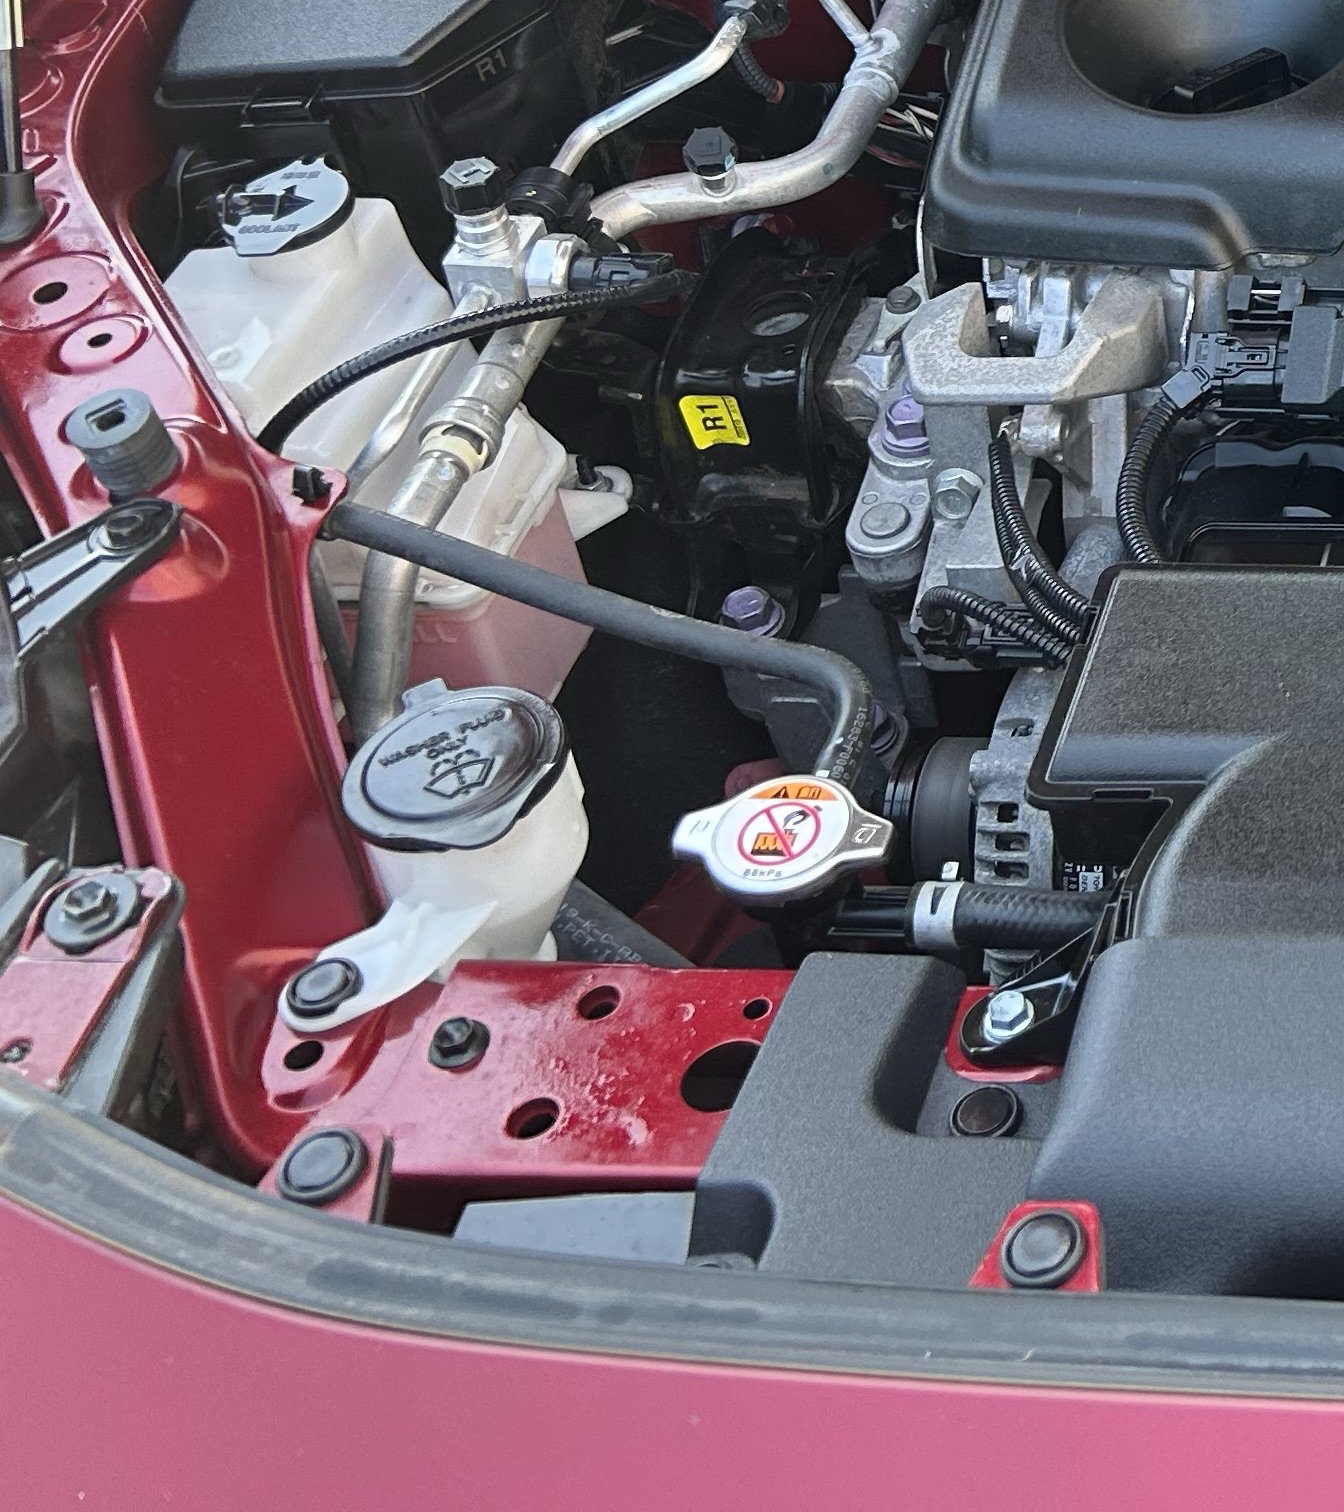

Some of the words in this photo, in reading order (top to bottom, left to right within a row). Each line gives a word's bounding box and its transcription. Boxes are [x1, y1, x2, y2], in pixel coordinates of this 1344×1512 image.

[475, 49, 508, 82] R1
[696, 404, 728, 431] R1
[425, 735, 470, 759] ONLY
